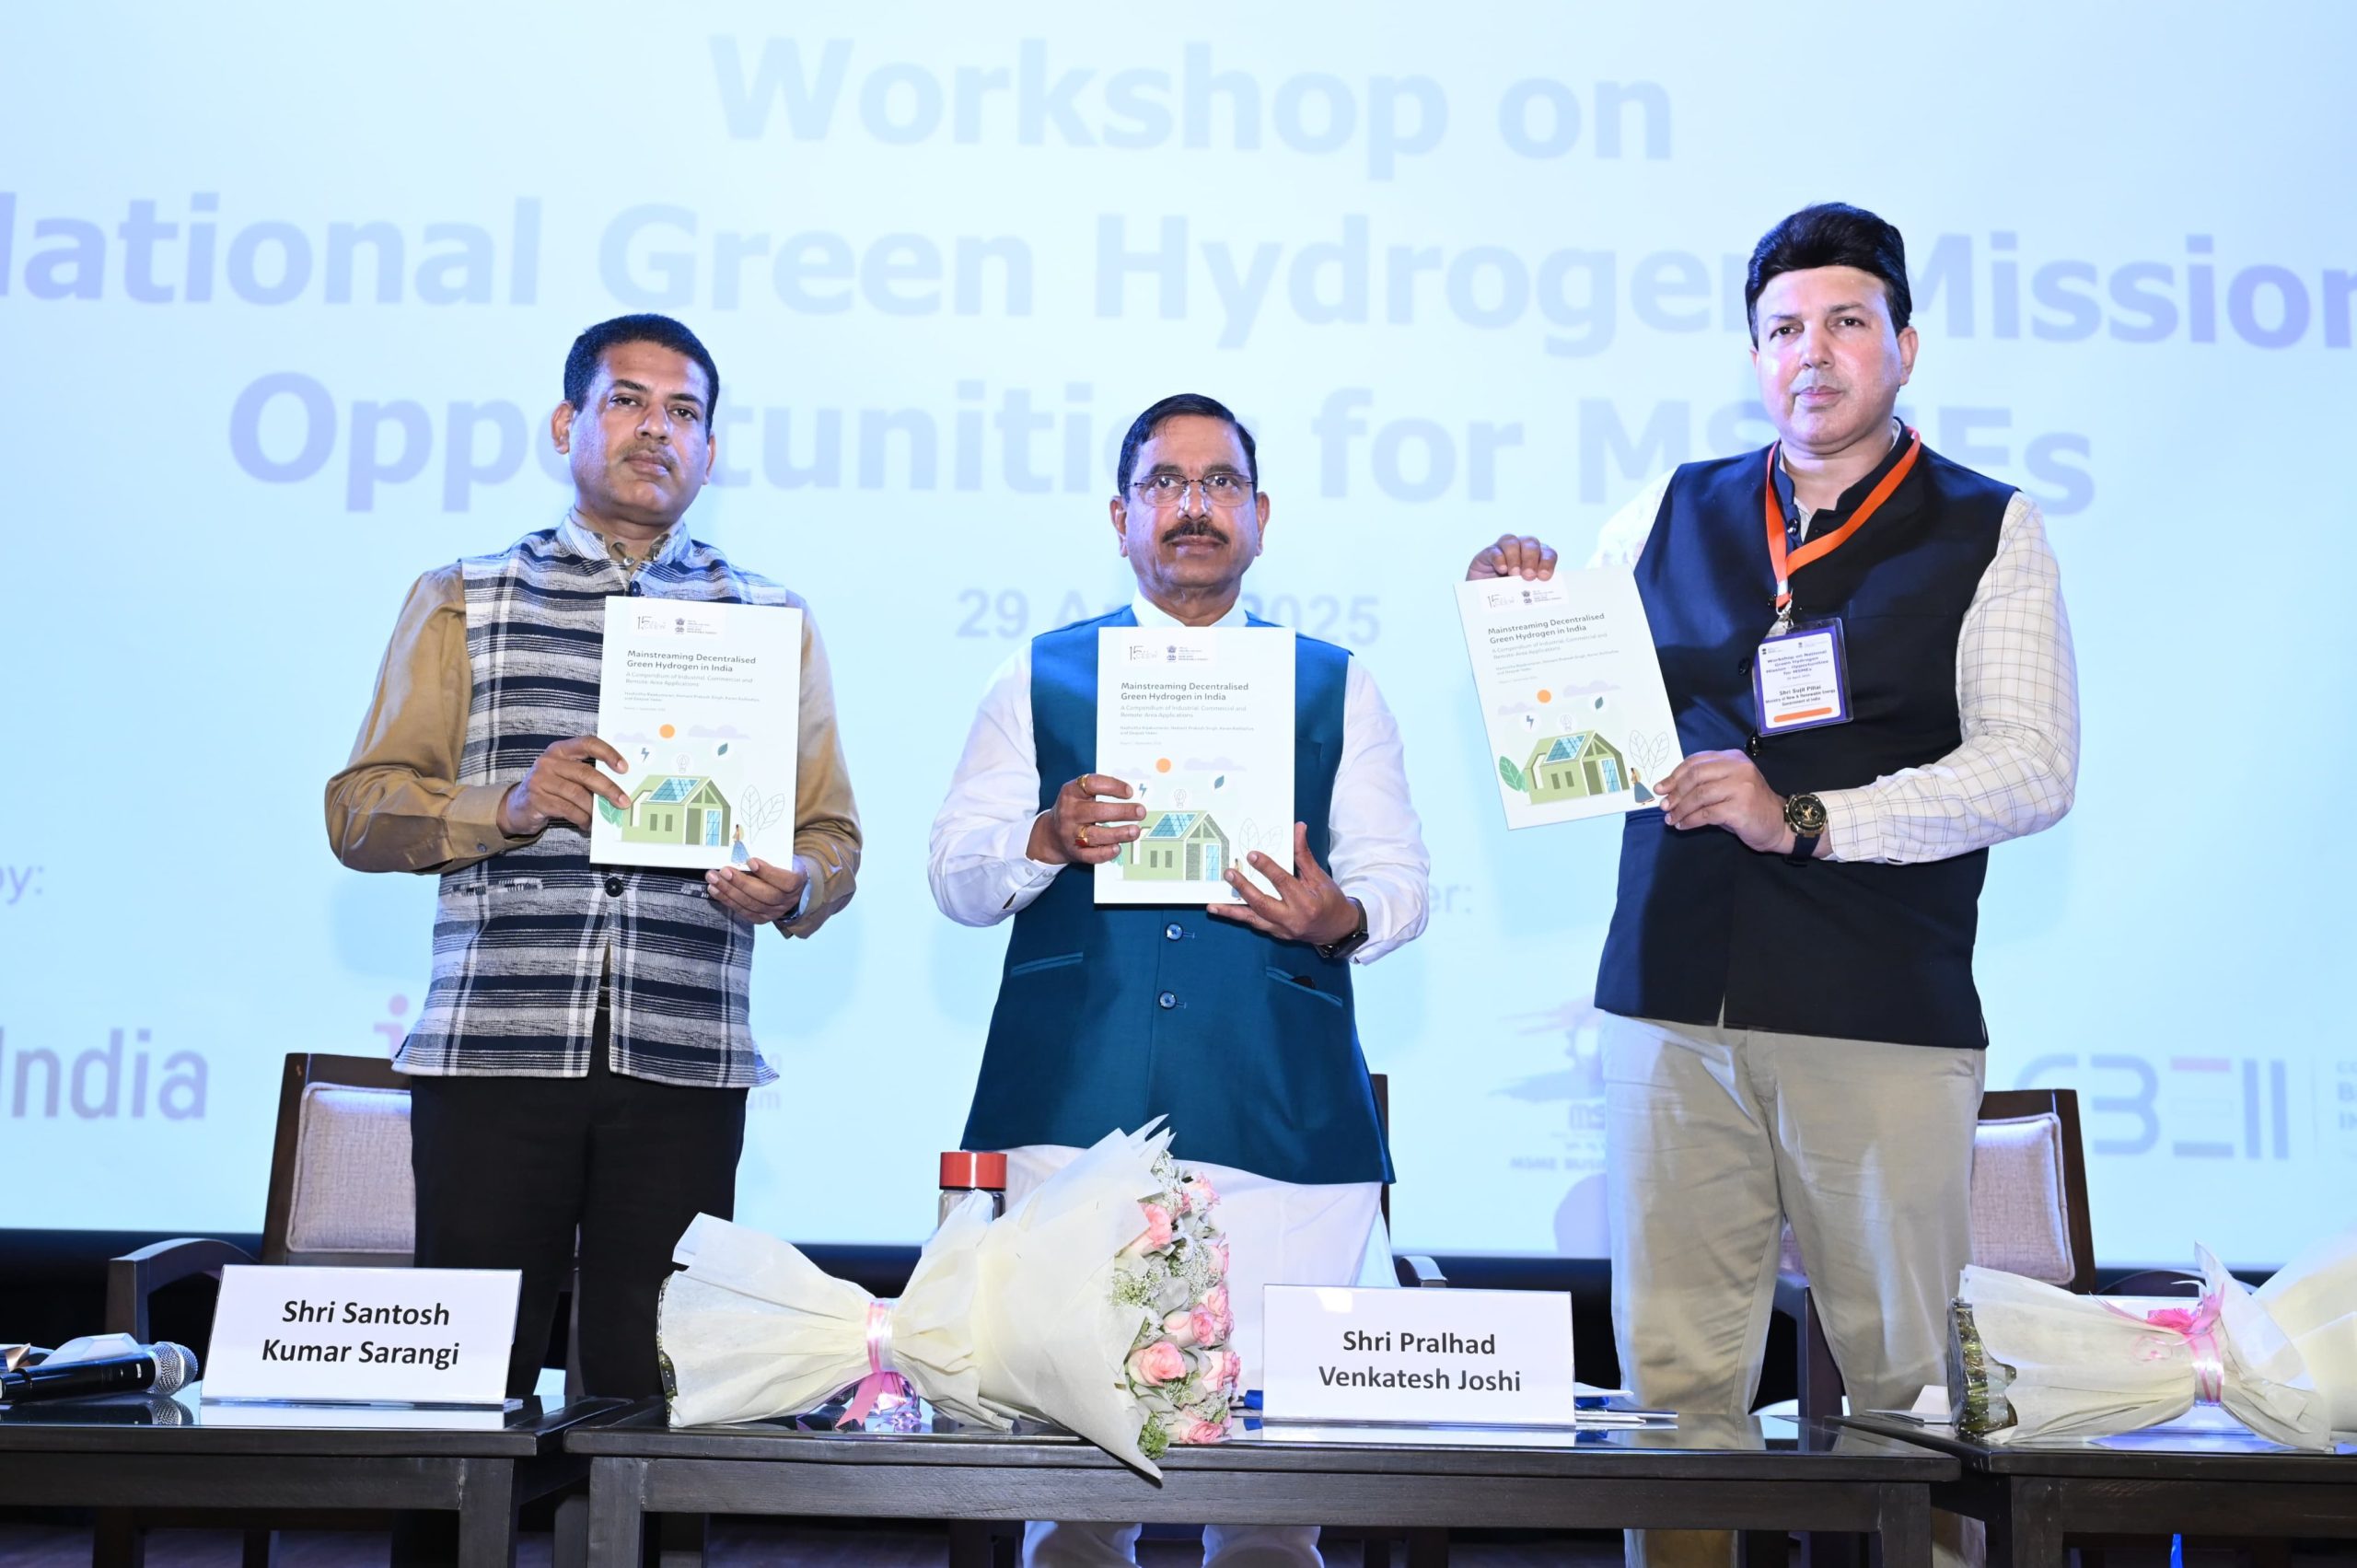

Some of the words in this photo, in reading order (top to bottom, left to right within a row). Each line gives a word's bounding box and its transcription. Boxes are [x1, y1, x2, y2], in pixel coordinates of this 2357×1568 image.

[709, 33, 1449, 182] Workshop
[1497, 71, 1674, 162] on
[0, 192, 542, 307] ational
[597, 202, 1034, 319] Green
[1311, 387, 1526, 504] for
[955, 587, 1029, 639] 29
[1488, 621, 1549, 634] Mainstreaming
[1550, 613, 1604, 625] Decentralised
[1490, 635, 1514, 644] Green
[1516, 630, 1556, 640] Hydrogen
[627, 650, 693, 662] Mainstreaming
[696, 654, 756, 664] Decentralised
[656, 661, 699, 671] Hydrogen
[1121, 682, 1187, 691] Mainstreaming
[1149, 693, 1192, 702] Hydrogen
[0, 1026, 210, 1121] ndia
[282, 1299, 336, 1323] Shri
[342, 1302, 450, 1326] Santosh
[261, 1339, 352, 1363] Kumar
[358, 1341, 460, 1371] Sarangi
[1342, 1330, 1391, 1352] Shri
[1400, 1332, 1495, 1355] Pralhad
[1318, 1365, 1450, 1389] Venkatesh
[1457, 1369, 1521, 1392] Joshi
